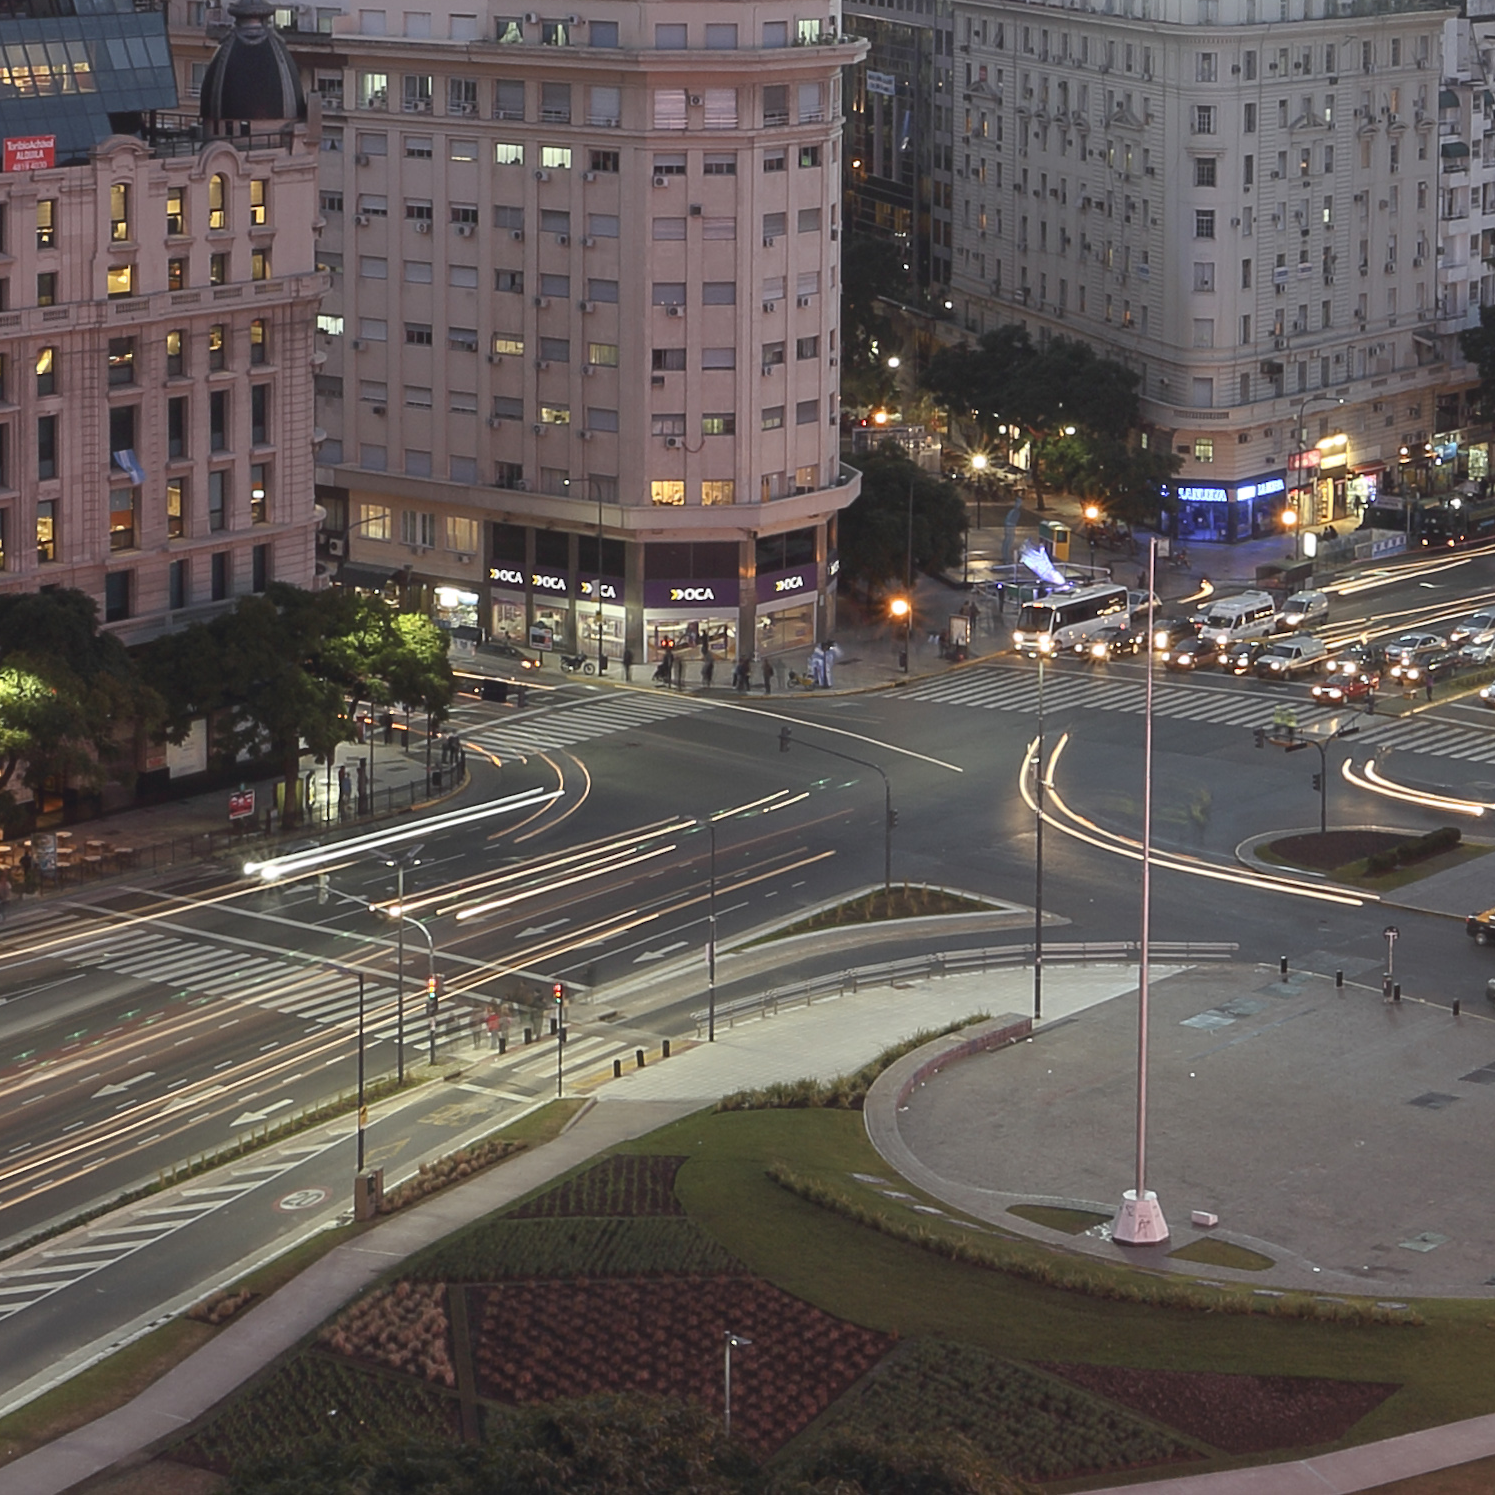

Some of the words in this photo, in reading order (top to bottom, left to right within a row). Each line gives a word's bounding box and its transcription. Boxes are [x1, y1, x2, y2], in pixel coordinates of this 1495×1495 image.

[500, 569, 523, 584] OCA
[542, 576, 566, 591] OCA
[784, 576, 803, 590] OCA
[596, 584, 616, 599] CA
[684, 588, 715, 601] OCA
